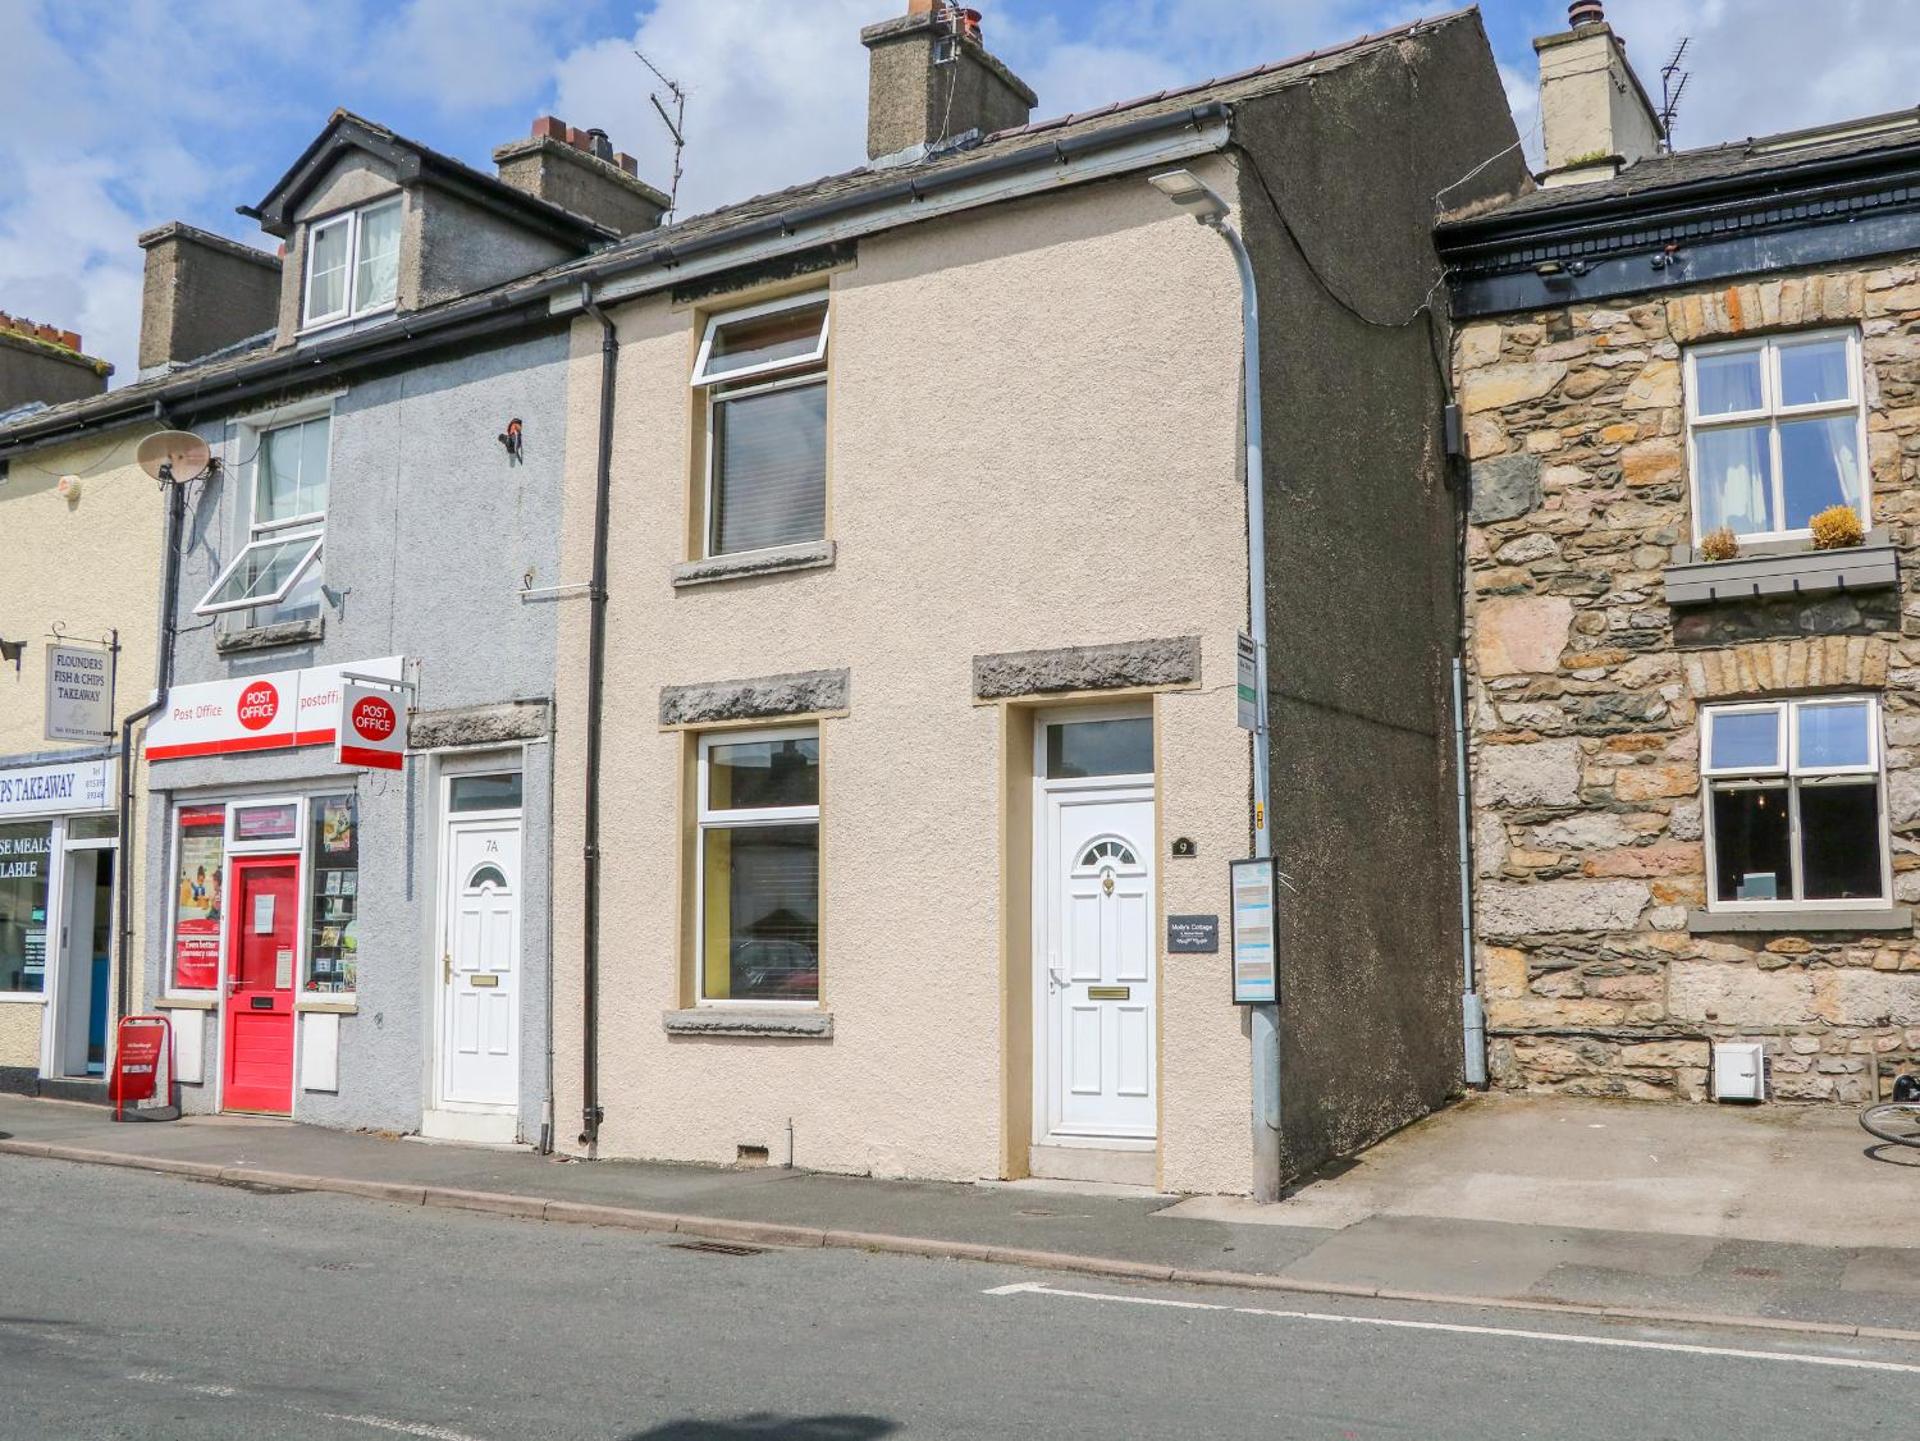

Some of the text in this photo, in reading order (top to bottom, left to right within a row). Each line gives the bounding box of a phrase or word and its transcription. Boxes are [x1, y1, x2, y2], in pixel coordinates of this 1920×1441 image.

[57, 655, 103, 670] FLOUNDERS
[54, 671, 104, 686] FISH & CHIPS
[58, 687, 100, 702] TAKEAWAY
[247, 691, 272, 704] POST
[301, 690, 342, 711] postoffi
[173, 704, 222, 720] Post Office
[240, 704, 274, 719] OFFICE
[363, 705, 388, 718] POST
[356, 717, 391, 731] OFFICE
[15, 773, 75, 801] TAKEAWAY
[14, 837, 52, 854] MEALS
[486, 840, 498, 852] 7A
[1180, 843, 1188, 853] 9
